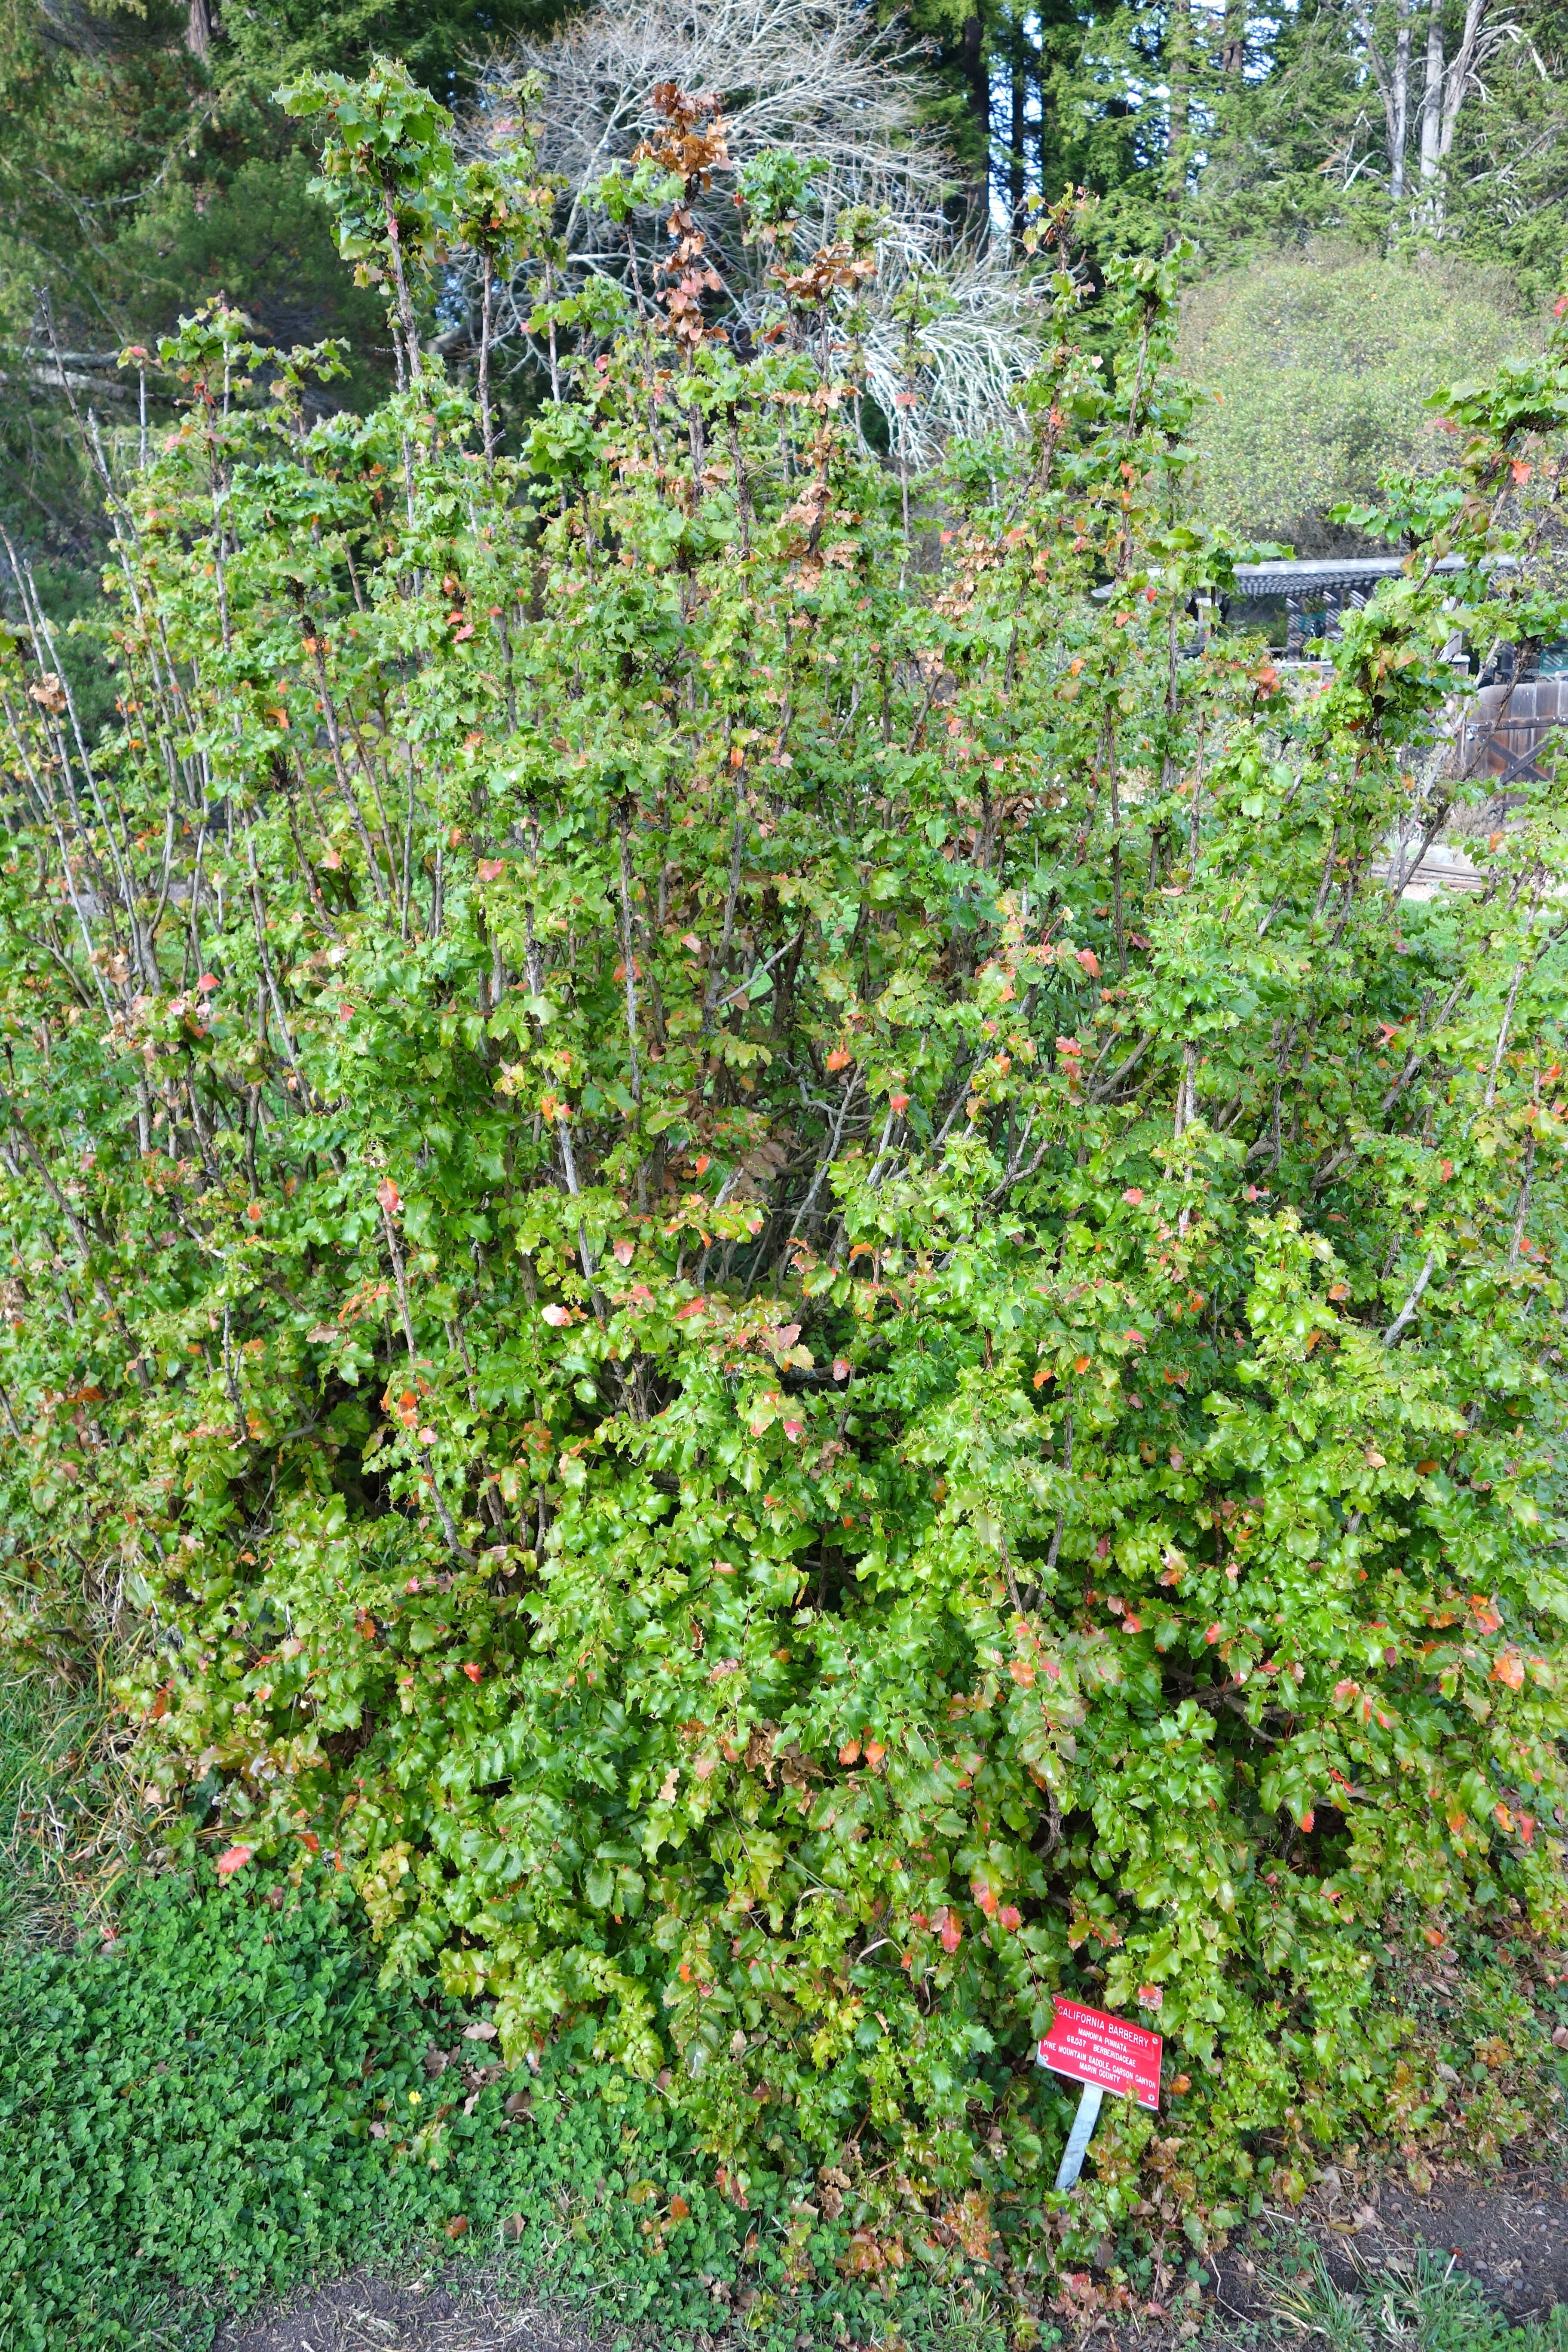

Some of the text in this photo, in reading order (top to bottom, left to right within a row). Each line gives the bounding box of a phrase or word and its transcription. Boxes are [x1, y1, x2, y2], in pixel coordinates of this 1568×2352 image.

[1058, 2006, 1148, 2047] CALIFORNIA BARBERRY
[1078, 2028, 1127, 2053] MAHONIA PINNATA
[1044, 2041, 1056, 2051] PINE
[1058, 2046, 1086, 2061] MOUNTAIN
[1112, 2065, 1133, 2079] CARSON
[1135, 2075, 1156, 2089] CANYON
[1093, 2045, 1136, 2067] BERBERIDACEAE
[1080, 2062, 1120, 2082] MARIN COUNTY
